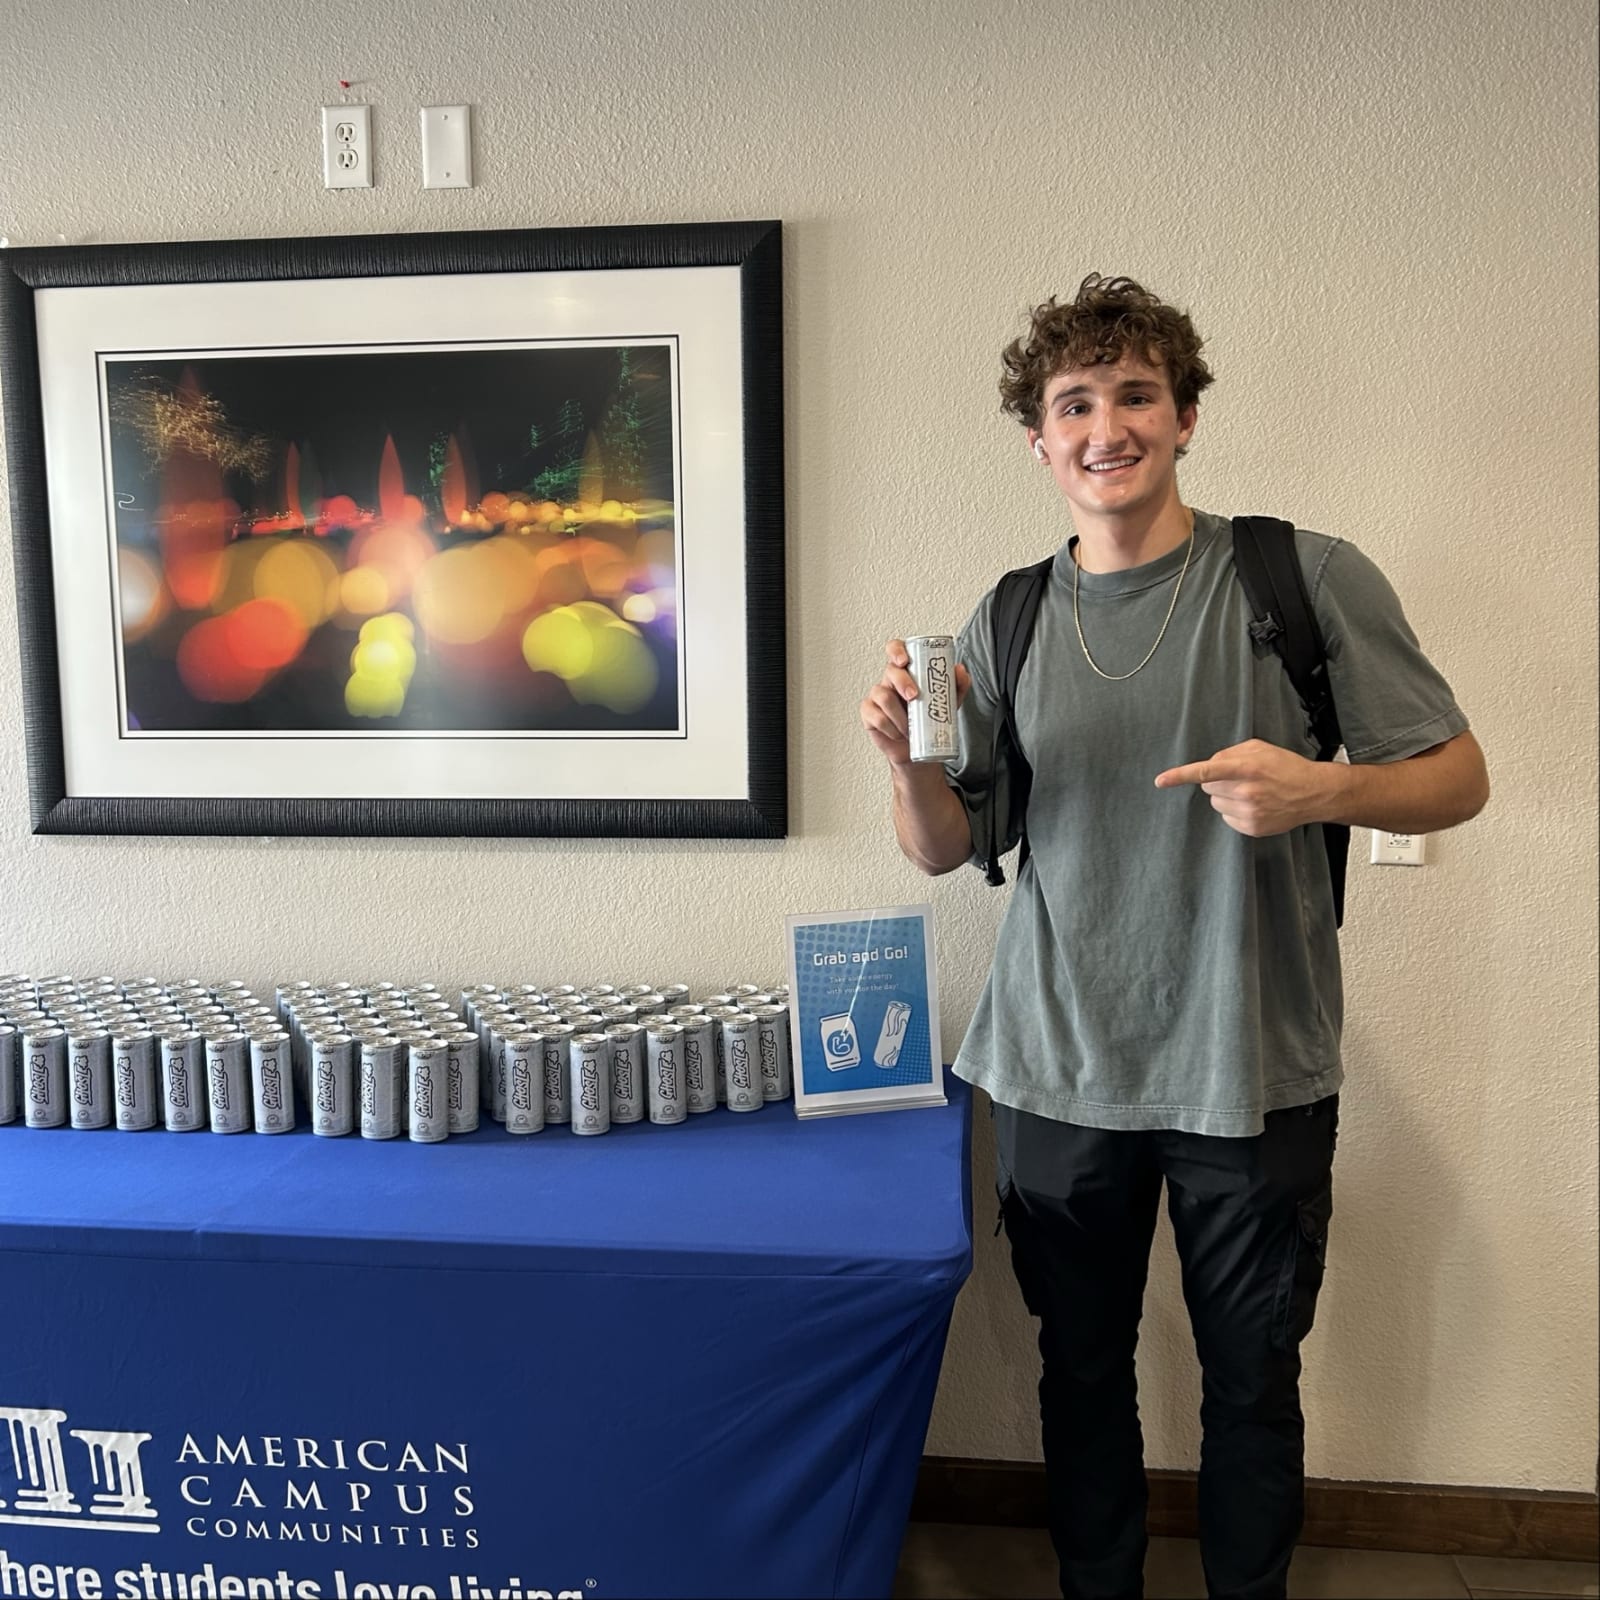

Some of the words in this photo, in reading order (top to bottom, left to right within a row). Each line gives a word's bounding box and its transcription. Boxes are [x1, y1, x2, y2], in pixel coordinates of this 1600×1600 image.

[928, 667, 952, 725] GHOST
[813, 951, 847, 966] Grab
[852, 948, 879, 963] and
[884, 945, 908, 960] Go!
[544, 1057, 563, 1100] GHOST
[614, 1056, 633, 1100] GHOST
[658, 1058, 678, 1101] GHOST
[685, 1047, 703, 1090] GHOST
[732, 1047, 751, 1089] GHOST
[760, 1038, 779, 1079] GHOST
[30, 1061, 50, 1105] GHOST
[74, 1062, 93, 1106] GHOST
[117, 1063, 136, 1108] GHOST
[169, 1064, 189, 1108] GHOST
[211, 1065, 231, 1110] GHOST
[261, 1065, 282, 1110] GHOST
[317, 1067, 336, 1114] GHOST
[415, 1073, 434, 1119] GHOST
[512, 1066, 531, 1111] GHOST
[580, 1067, 600, 1111] GHOST
[175, 1433, 469, 1474] AMERICAN
[180, 1475, 475, 1516] CAMPUS
[186, 1516, 479, 1549] COMMUNITIES
[114, 1563, 321, 1599] students
